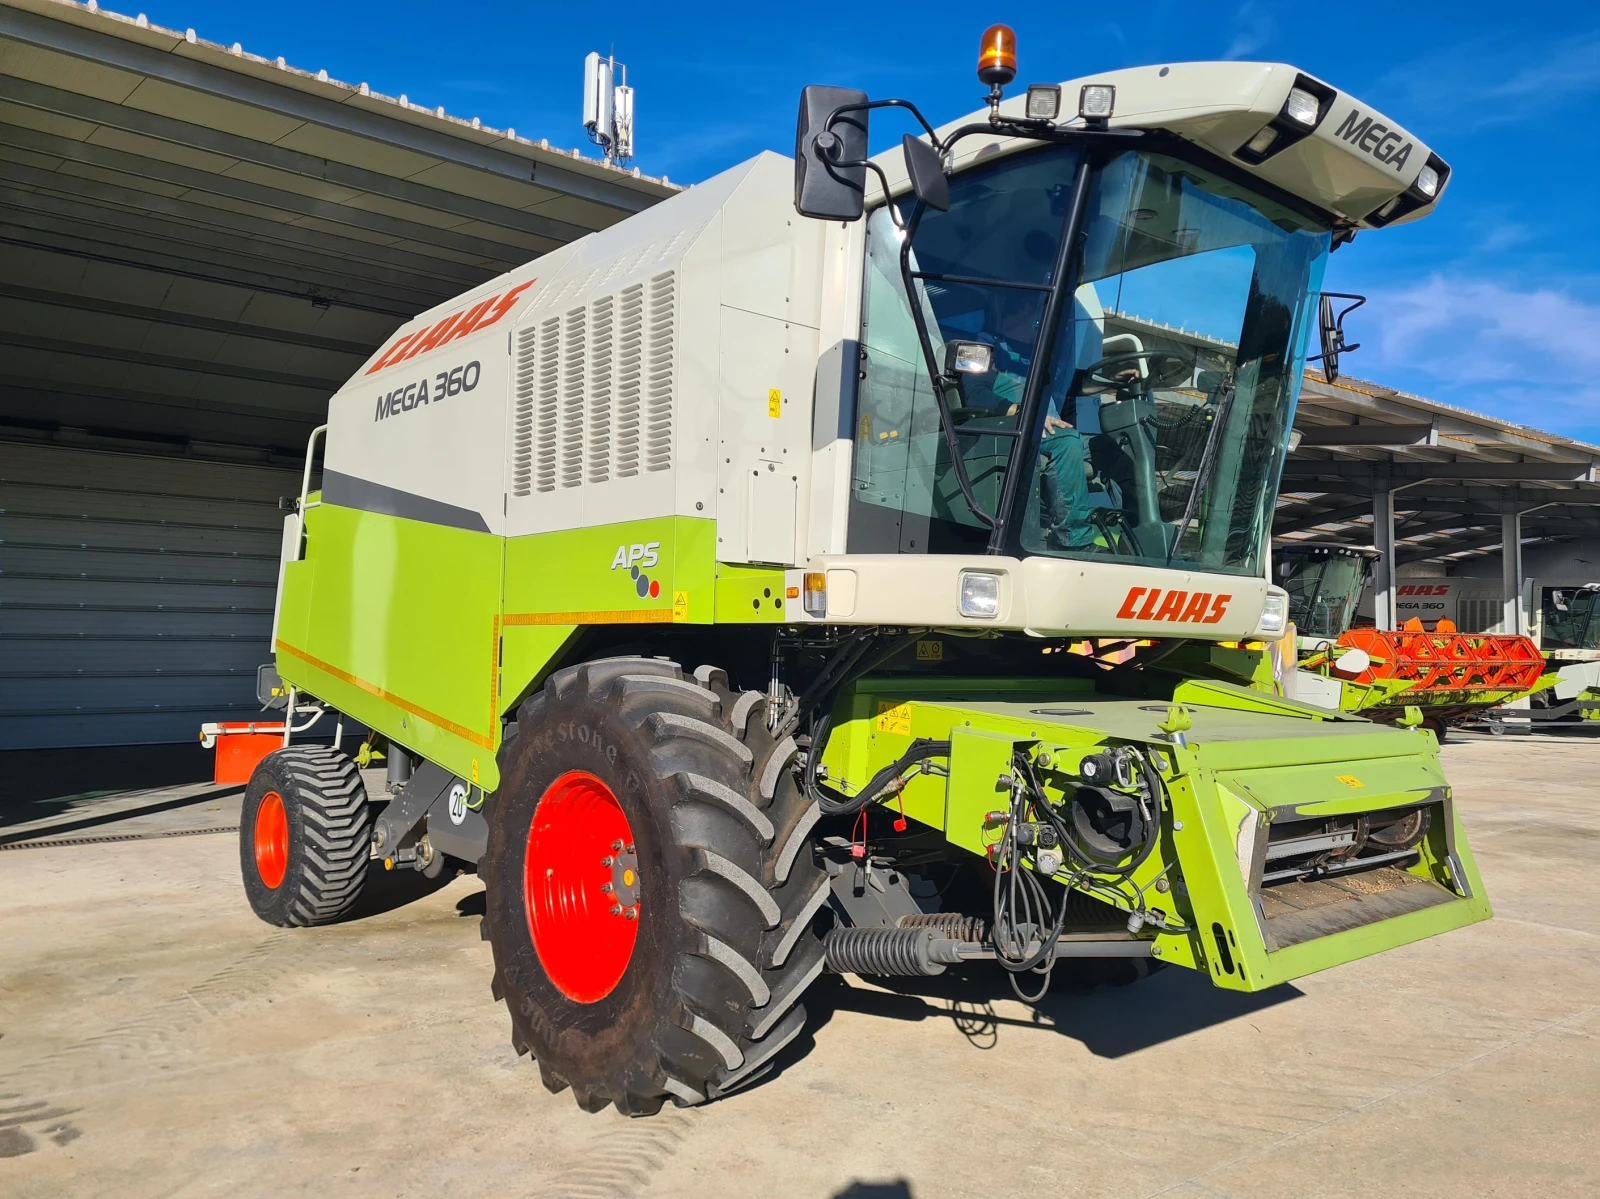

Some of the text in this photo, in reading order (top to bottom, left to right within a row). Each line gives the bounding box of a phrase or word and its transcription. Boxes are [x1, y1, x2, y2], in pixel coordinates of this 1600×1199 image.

[1334, 109, 1414, 172] MEGA
[364, 277, 538, 376] CLAAS
[375, 361, 481, 422] MEGA 360
[611, 542, 660, 570] APS
[1116, 586, 1233, 624] CLAAS
[1396, 584, 1450, 596] AAS
[1421, 602, 1445, 610] 360
[452, 791, 464, 818] 20
